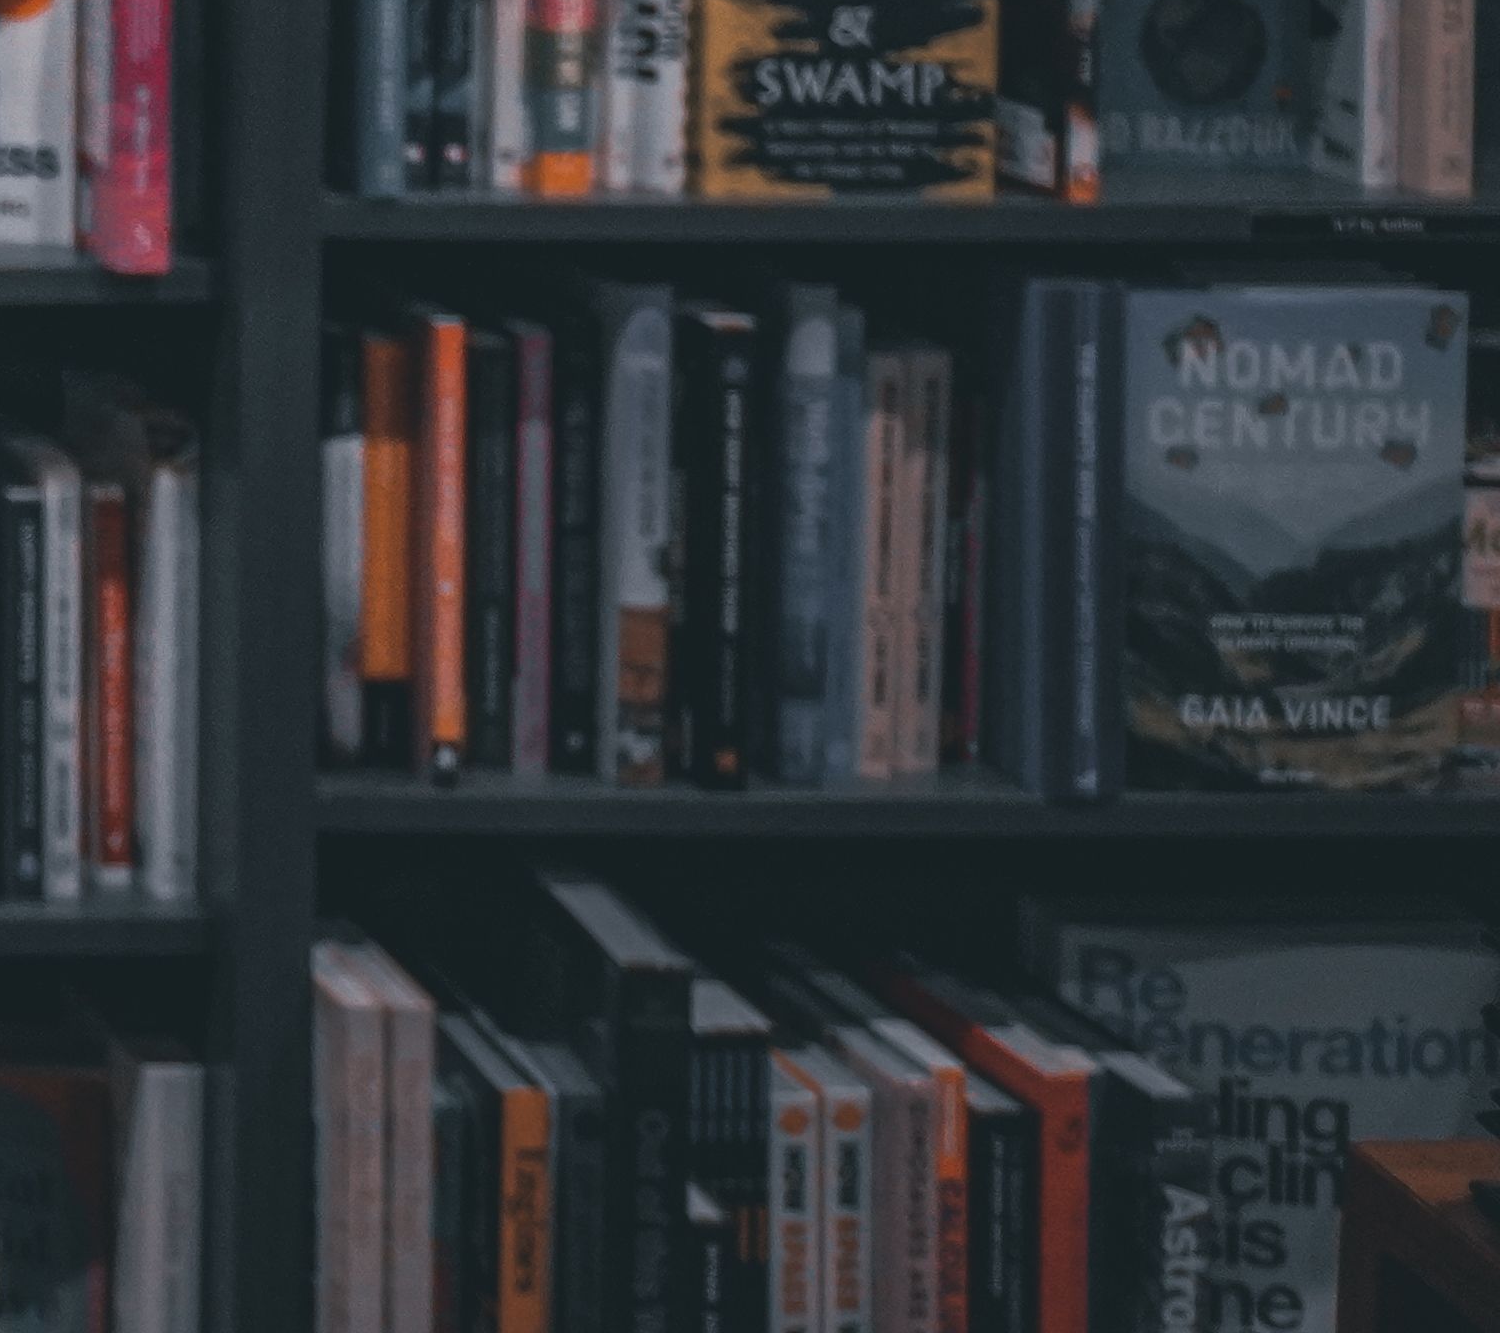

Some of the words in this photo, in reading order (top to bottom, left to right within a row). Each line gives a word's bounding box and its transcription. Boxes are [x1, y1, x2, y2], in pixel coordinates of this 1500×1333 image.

[830, 5, 875, 44] &
[754, 58, 949, 107] SWAMP
[1177, 340, 1403, 391] NOMAD
[1147, 396, 1434, 452] CENTURY
[1180, 695, 1268, 730] GAIA
[1279, 695, 1393, 731] VINCE
[1078, 947, 1188, 1014] Re
